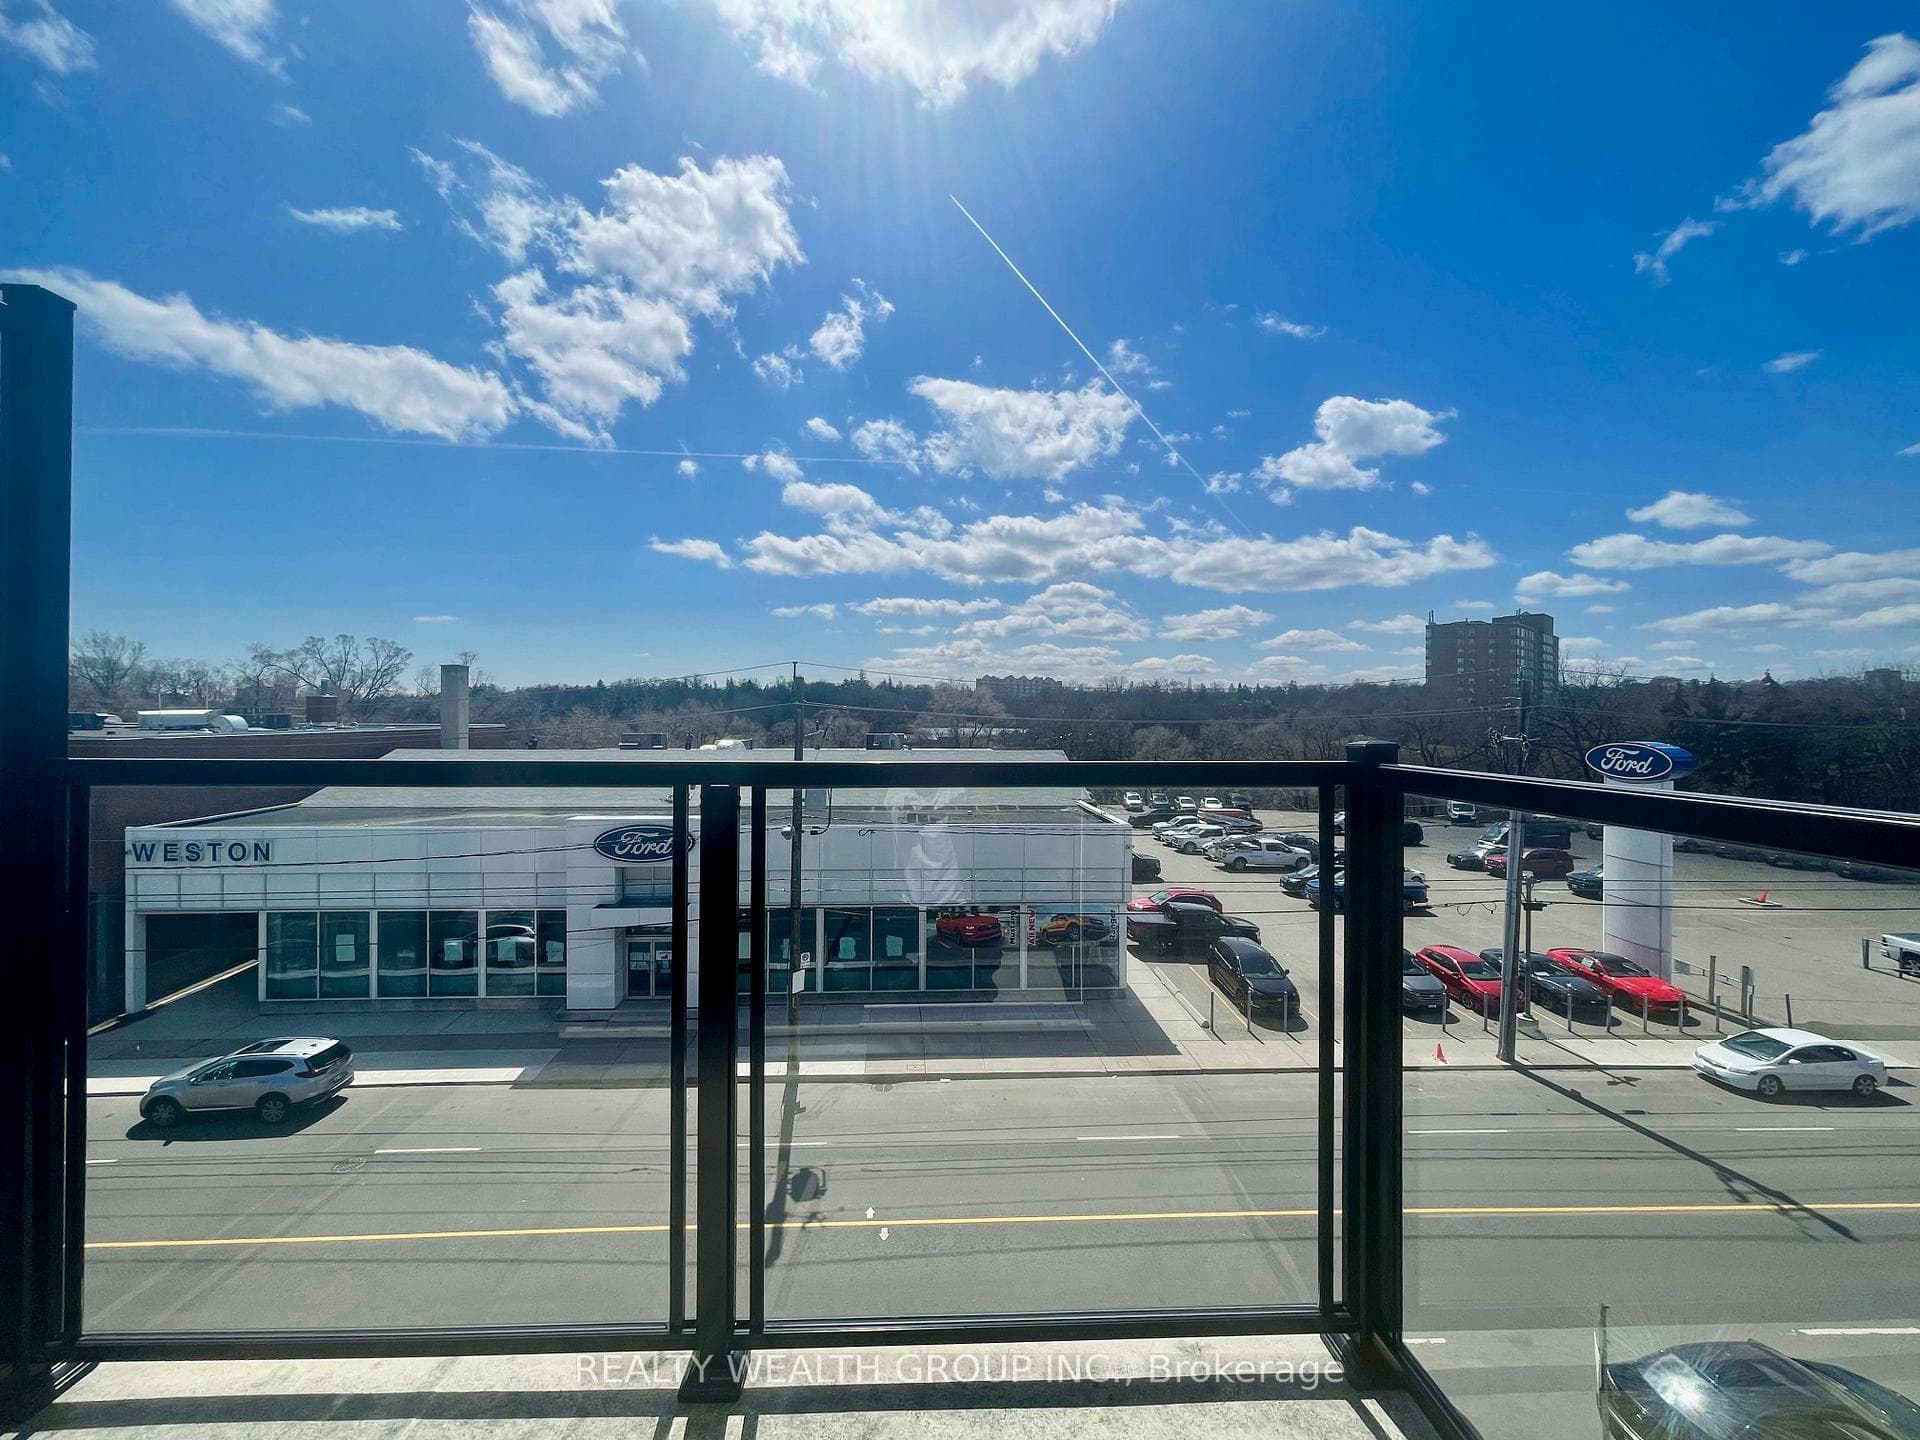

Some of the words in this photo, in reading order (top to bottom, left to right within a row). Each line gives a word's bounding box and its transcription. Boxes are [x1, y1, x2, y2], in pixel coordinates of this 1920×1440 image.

[1601, 748, 1653, 773] Ford
[131, 842, 271, 862] WESTON
[614, 831, 673, 854] Ford
[1009, 910, 1017, 945] Mustang
[1110, 909, 1118, 940] Ranger
